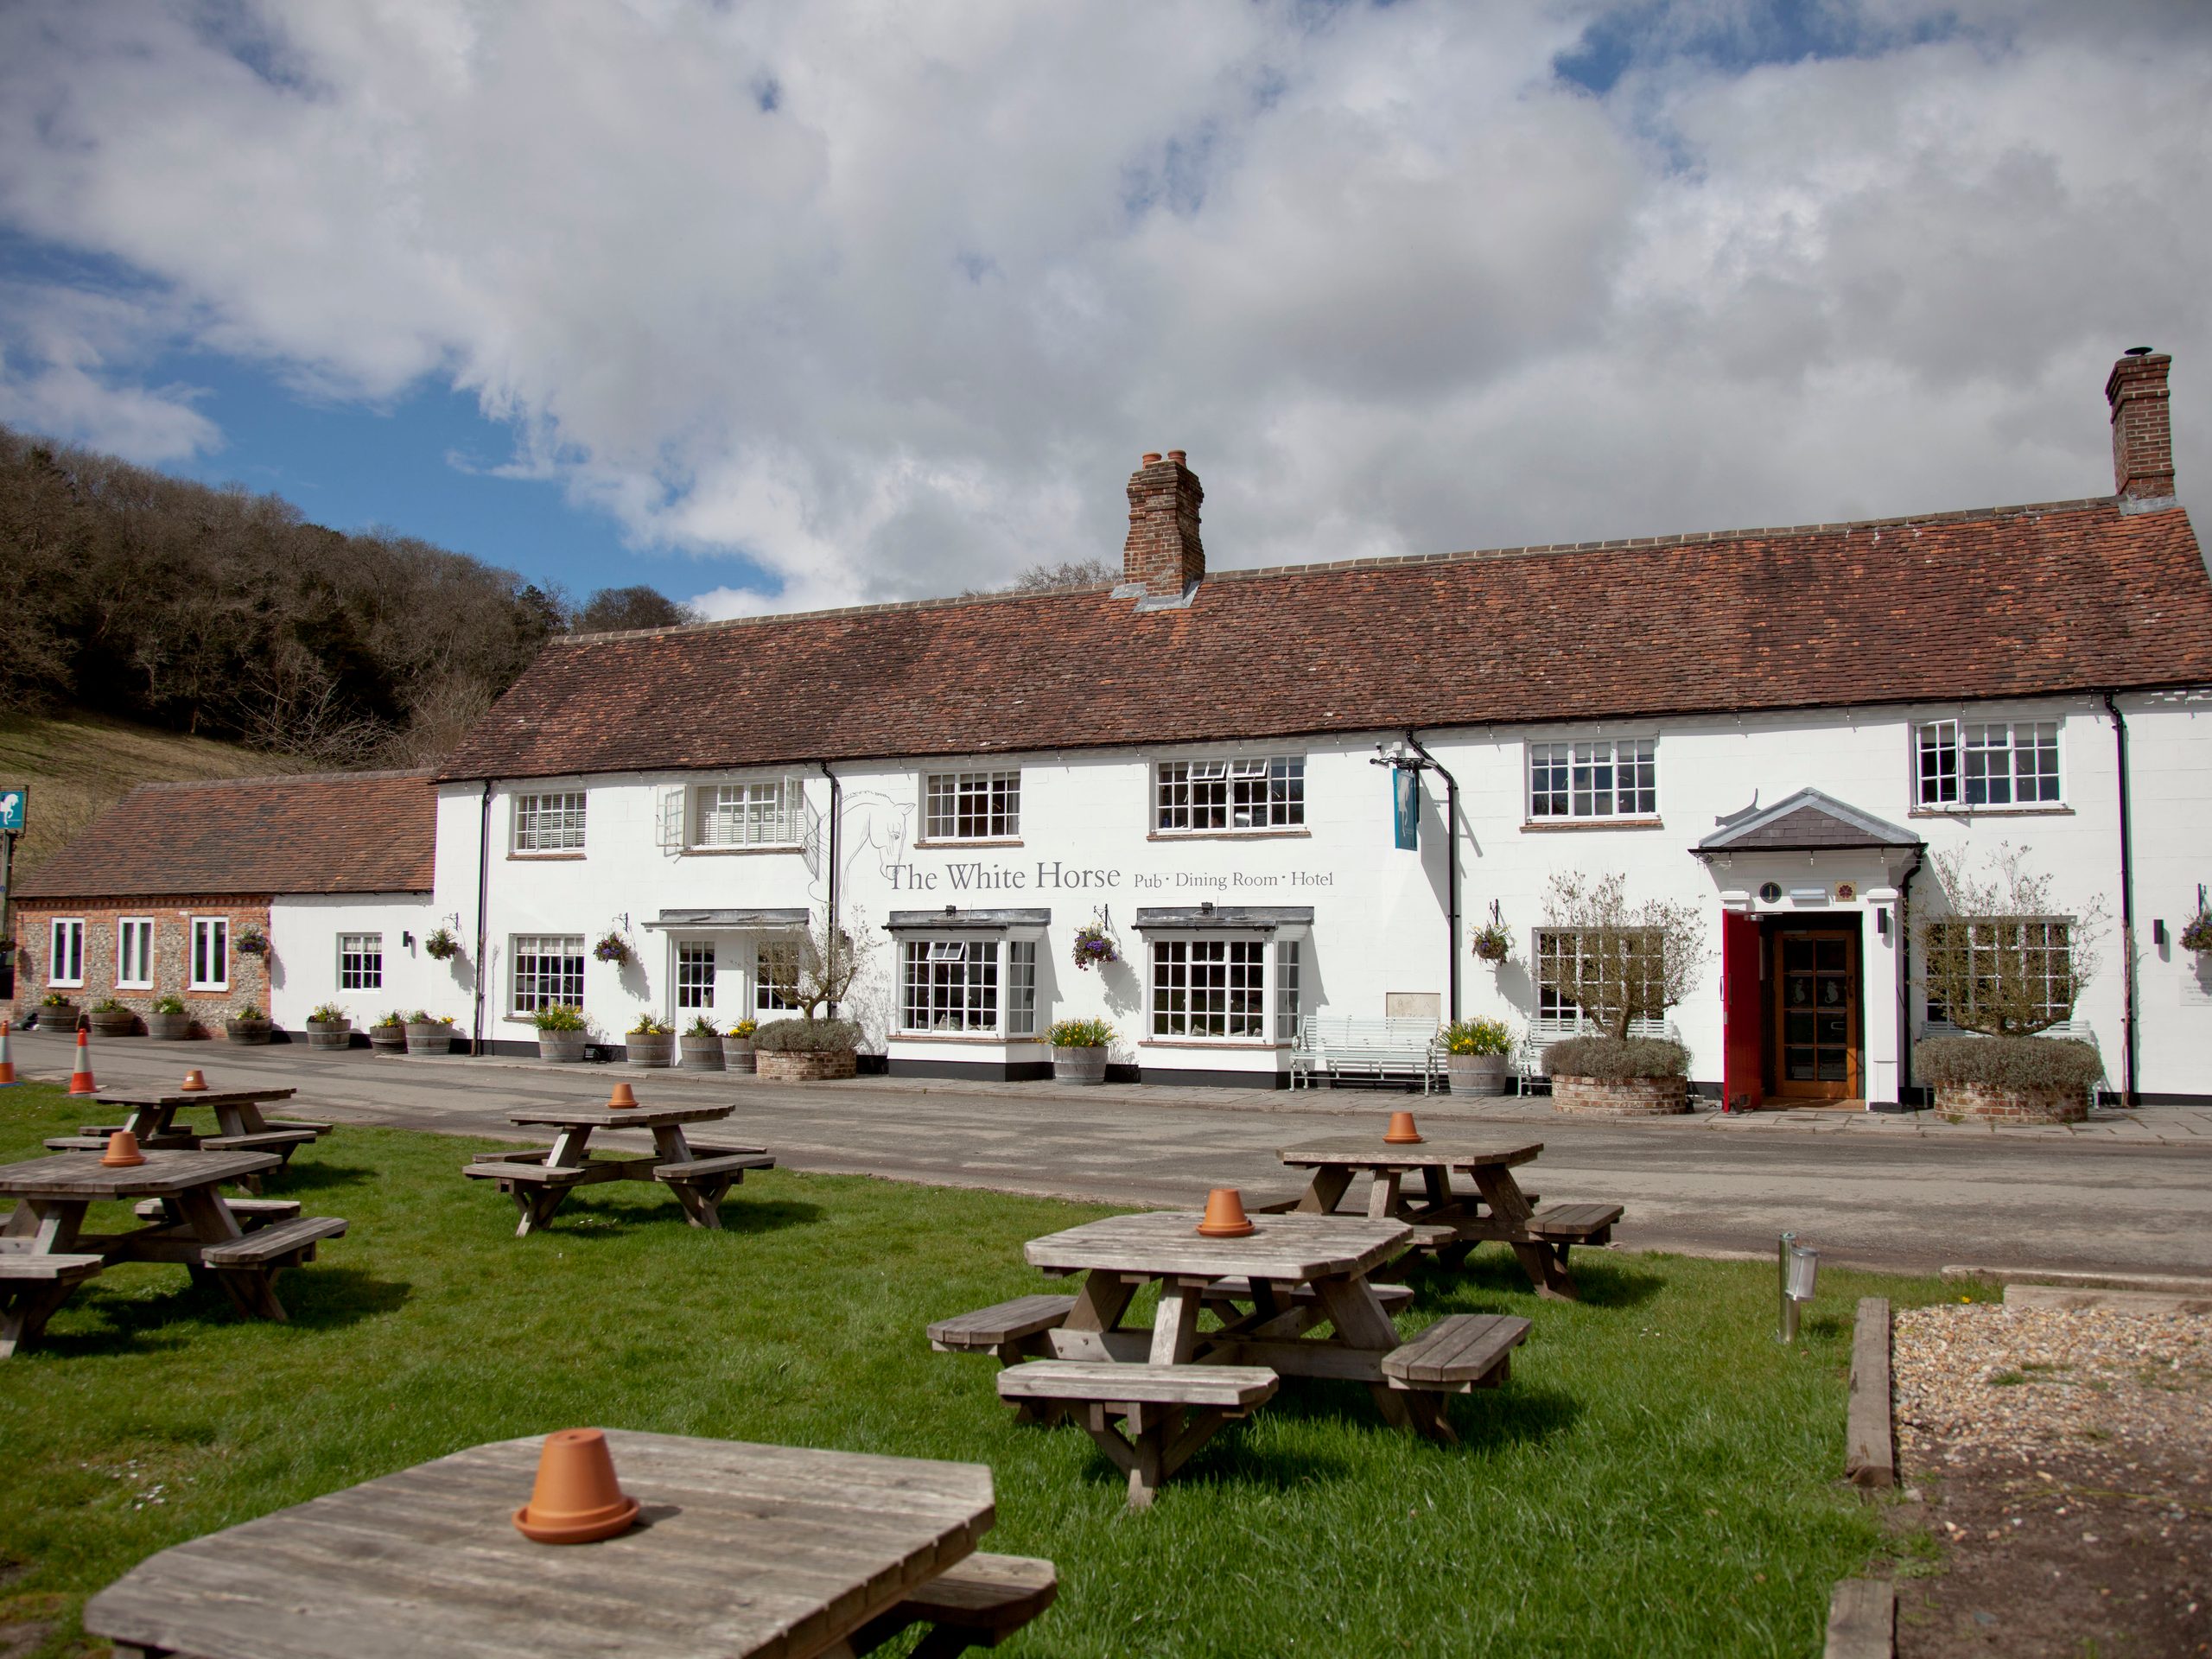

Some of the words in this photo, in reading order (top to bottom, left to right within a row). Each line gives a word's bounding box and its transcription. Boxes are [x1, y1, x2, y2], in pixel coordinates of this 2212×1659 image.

[887, 863, 938, 890] The
[945, 862, 1026, 890] White
[1035, 861, 1121, 888] Horse
[1134, 874, 1162, 888] Pub
[1175, 872, 1227, 891] Dining
[1232, 872, 1278, 887] Room
[1291, 871, 1333, 886] Hotel
